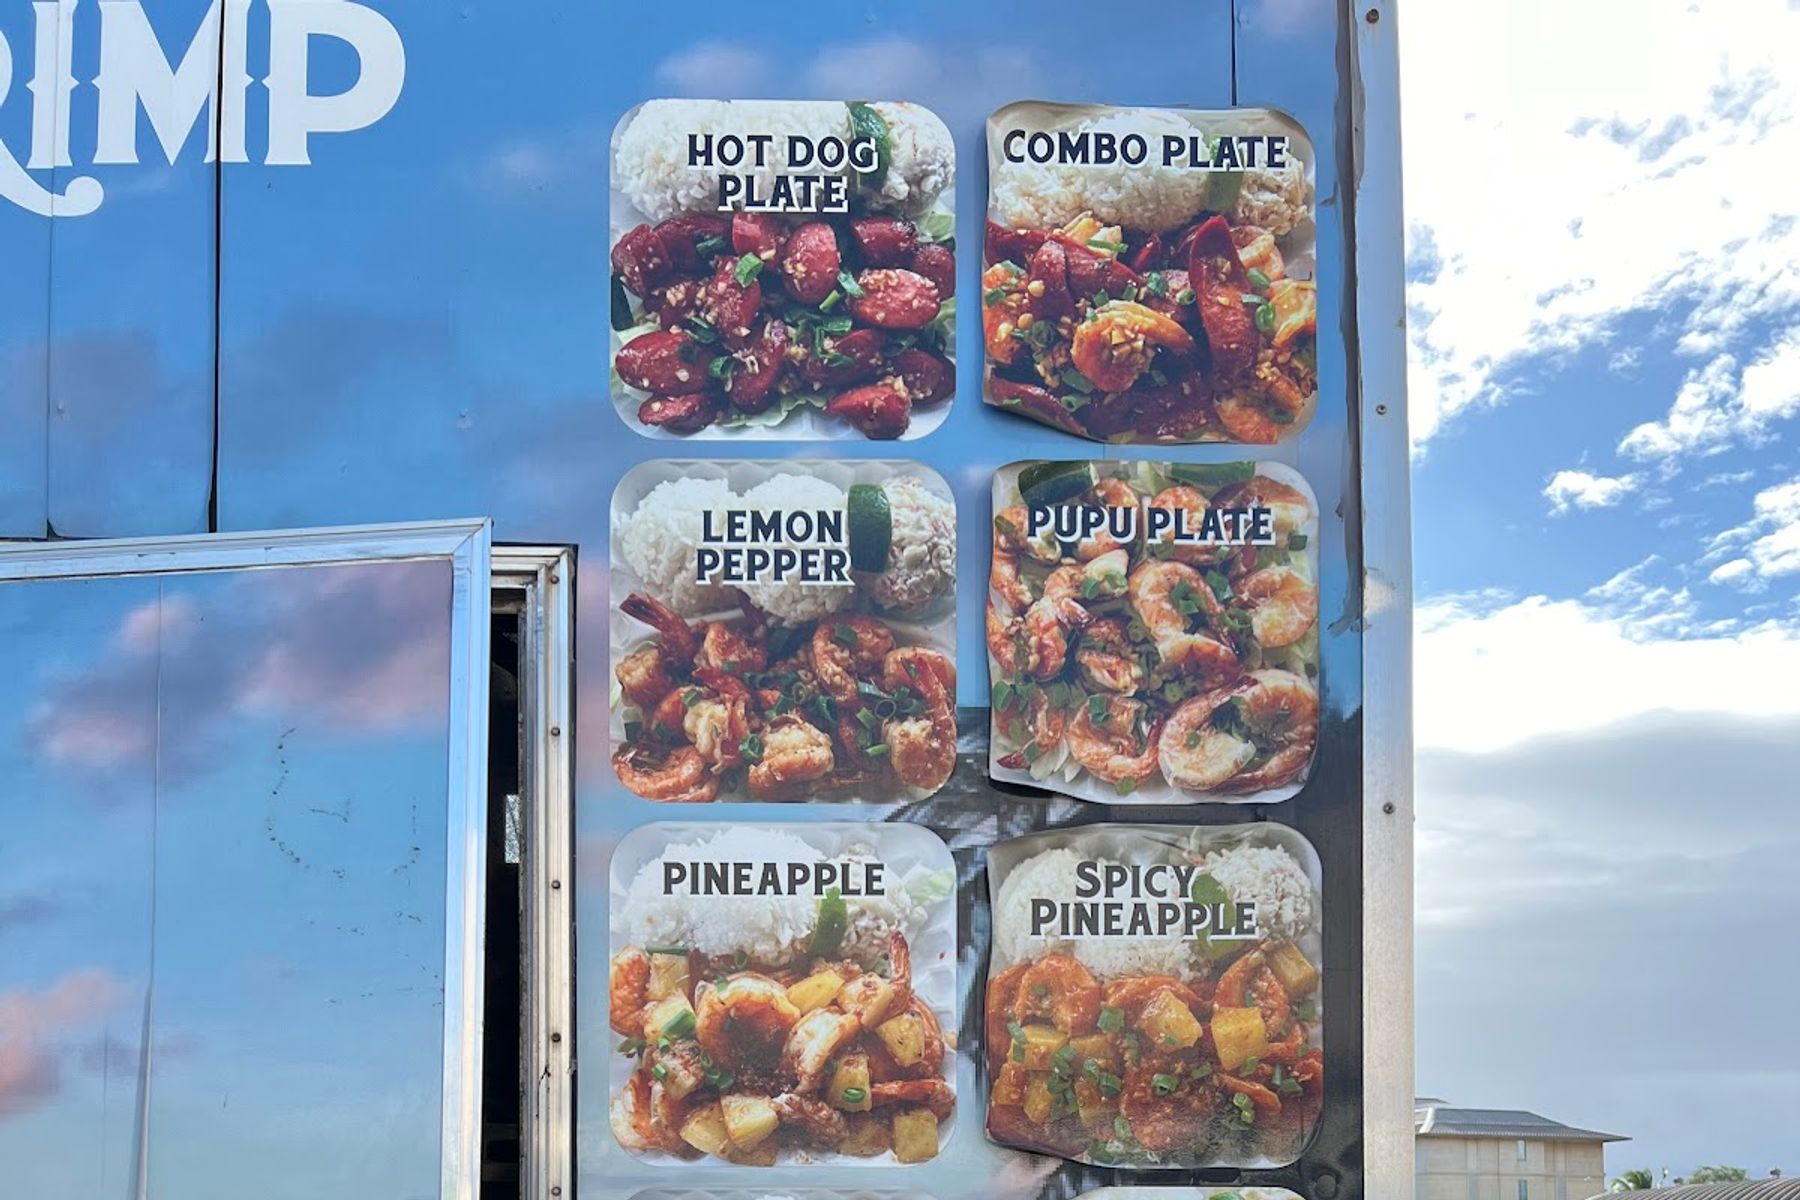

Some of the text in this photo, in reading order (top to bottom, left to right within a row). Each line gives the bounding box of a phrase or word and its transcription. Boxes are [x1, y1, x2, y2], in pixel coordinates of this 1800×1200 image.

[688, 134, 879, 172] HOT DOG
[1003, 129, 1289, 171] COMBO PLATE
[717, 175, 849, 213] PLATE
[702, 508, 844, 545] LEMON
[1027, 505, 1276, 544] PUPU PLATE
[697, 547, 854, 587] PEPPER
[662, 860, 887, 898] PINEAPPLE
[1075, 860, 1195, 899] SPICY
[1030, 899, 1258, 940] PINEAPPLE
